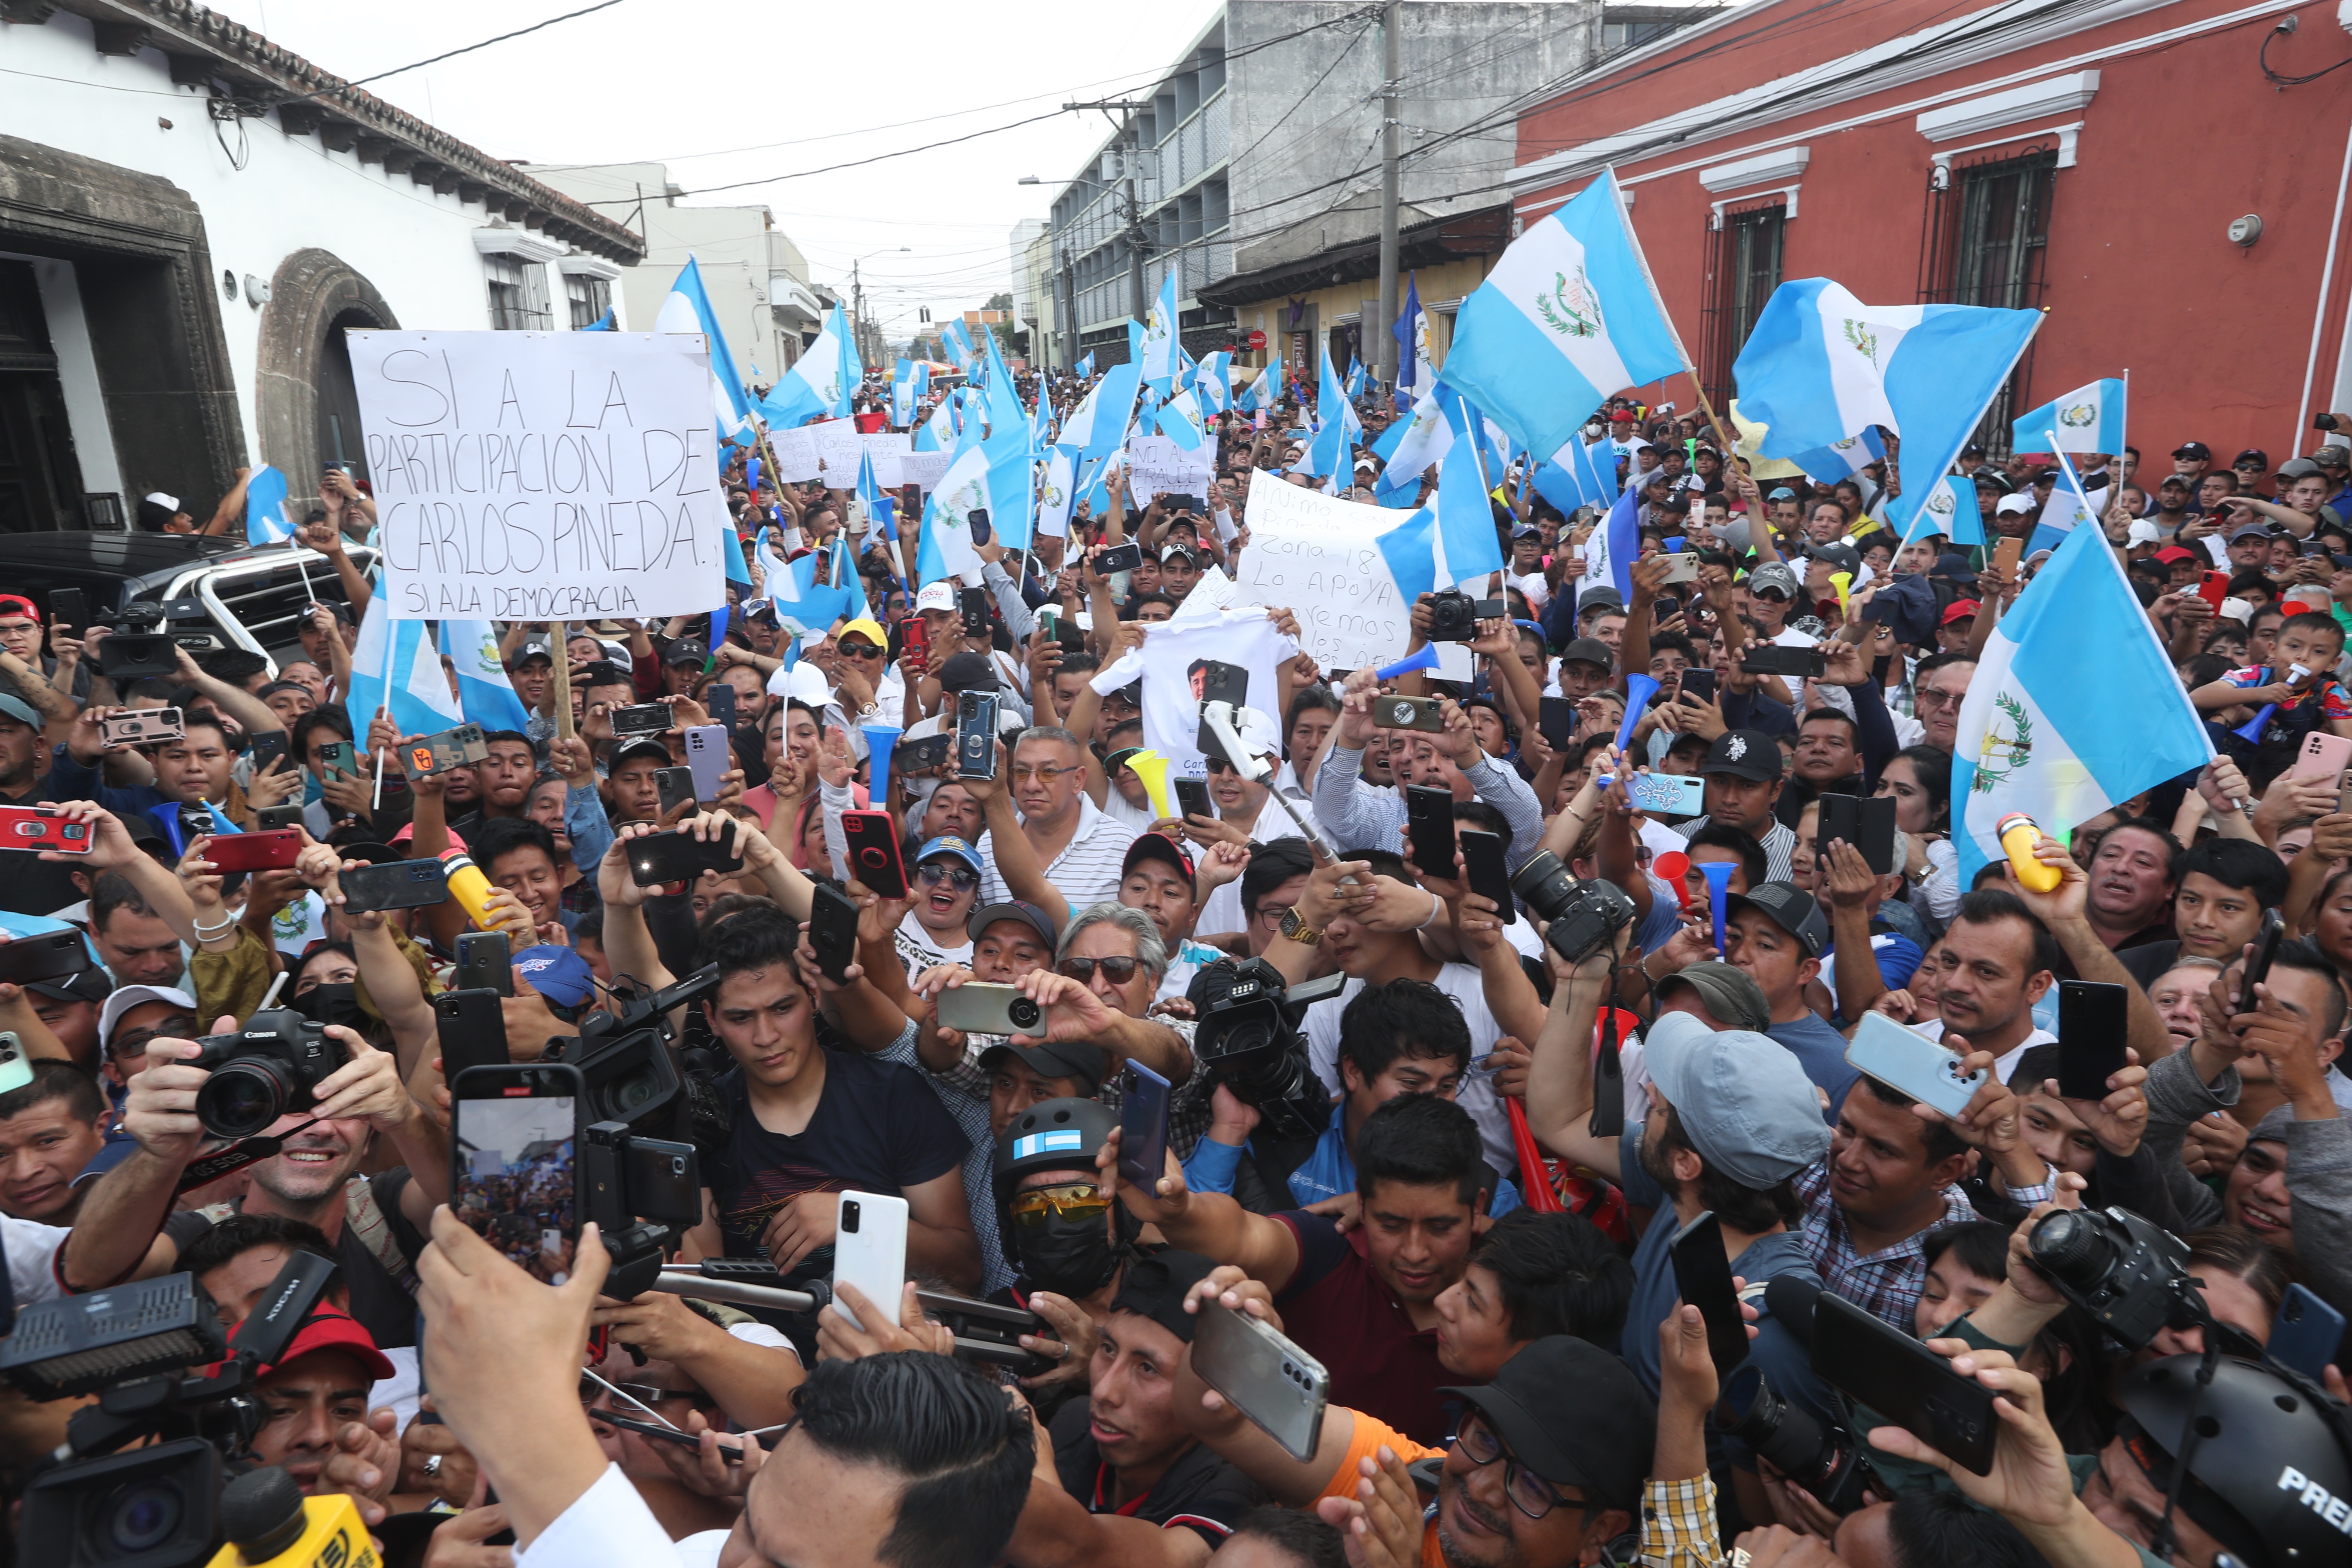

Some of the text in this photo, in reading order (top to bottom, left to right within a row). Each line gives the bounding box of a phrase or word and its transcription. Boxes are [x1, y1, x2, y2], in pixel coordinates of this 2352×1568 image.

[381, 349, 633, 430] SI A LA
[822, 435, 855, 450] Carlos
[1135, 445, 1188, 463] NO AL
[368, 429, 710, 496] PARTICIPACION DE
[1134, 466, 1200, 485] FRAUDE
[385, 502, 545, 575] CARLOS
[1255, 534, 1377, 575] Zona 18
[1253, 561, 1284, 586] Lo
[405, 583, 430, 612] SI
[493, 585, 639, 617] DEMOCRACIA
[1311, 630, 1342, 652] los
[212, 1153, 250, 1169] EOS
